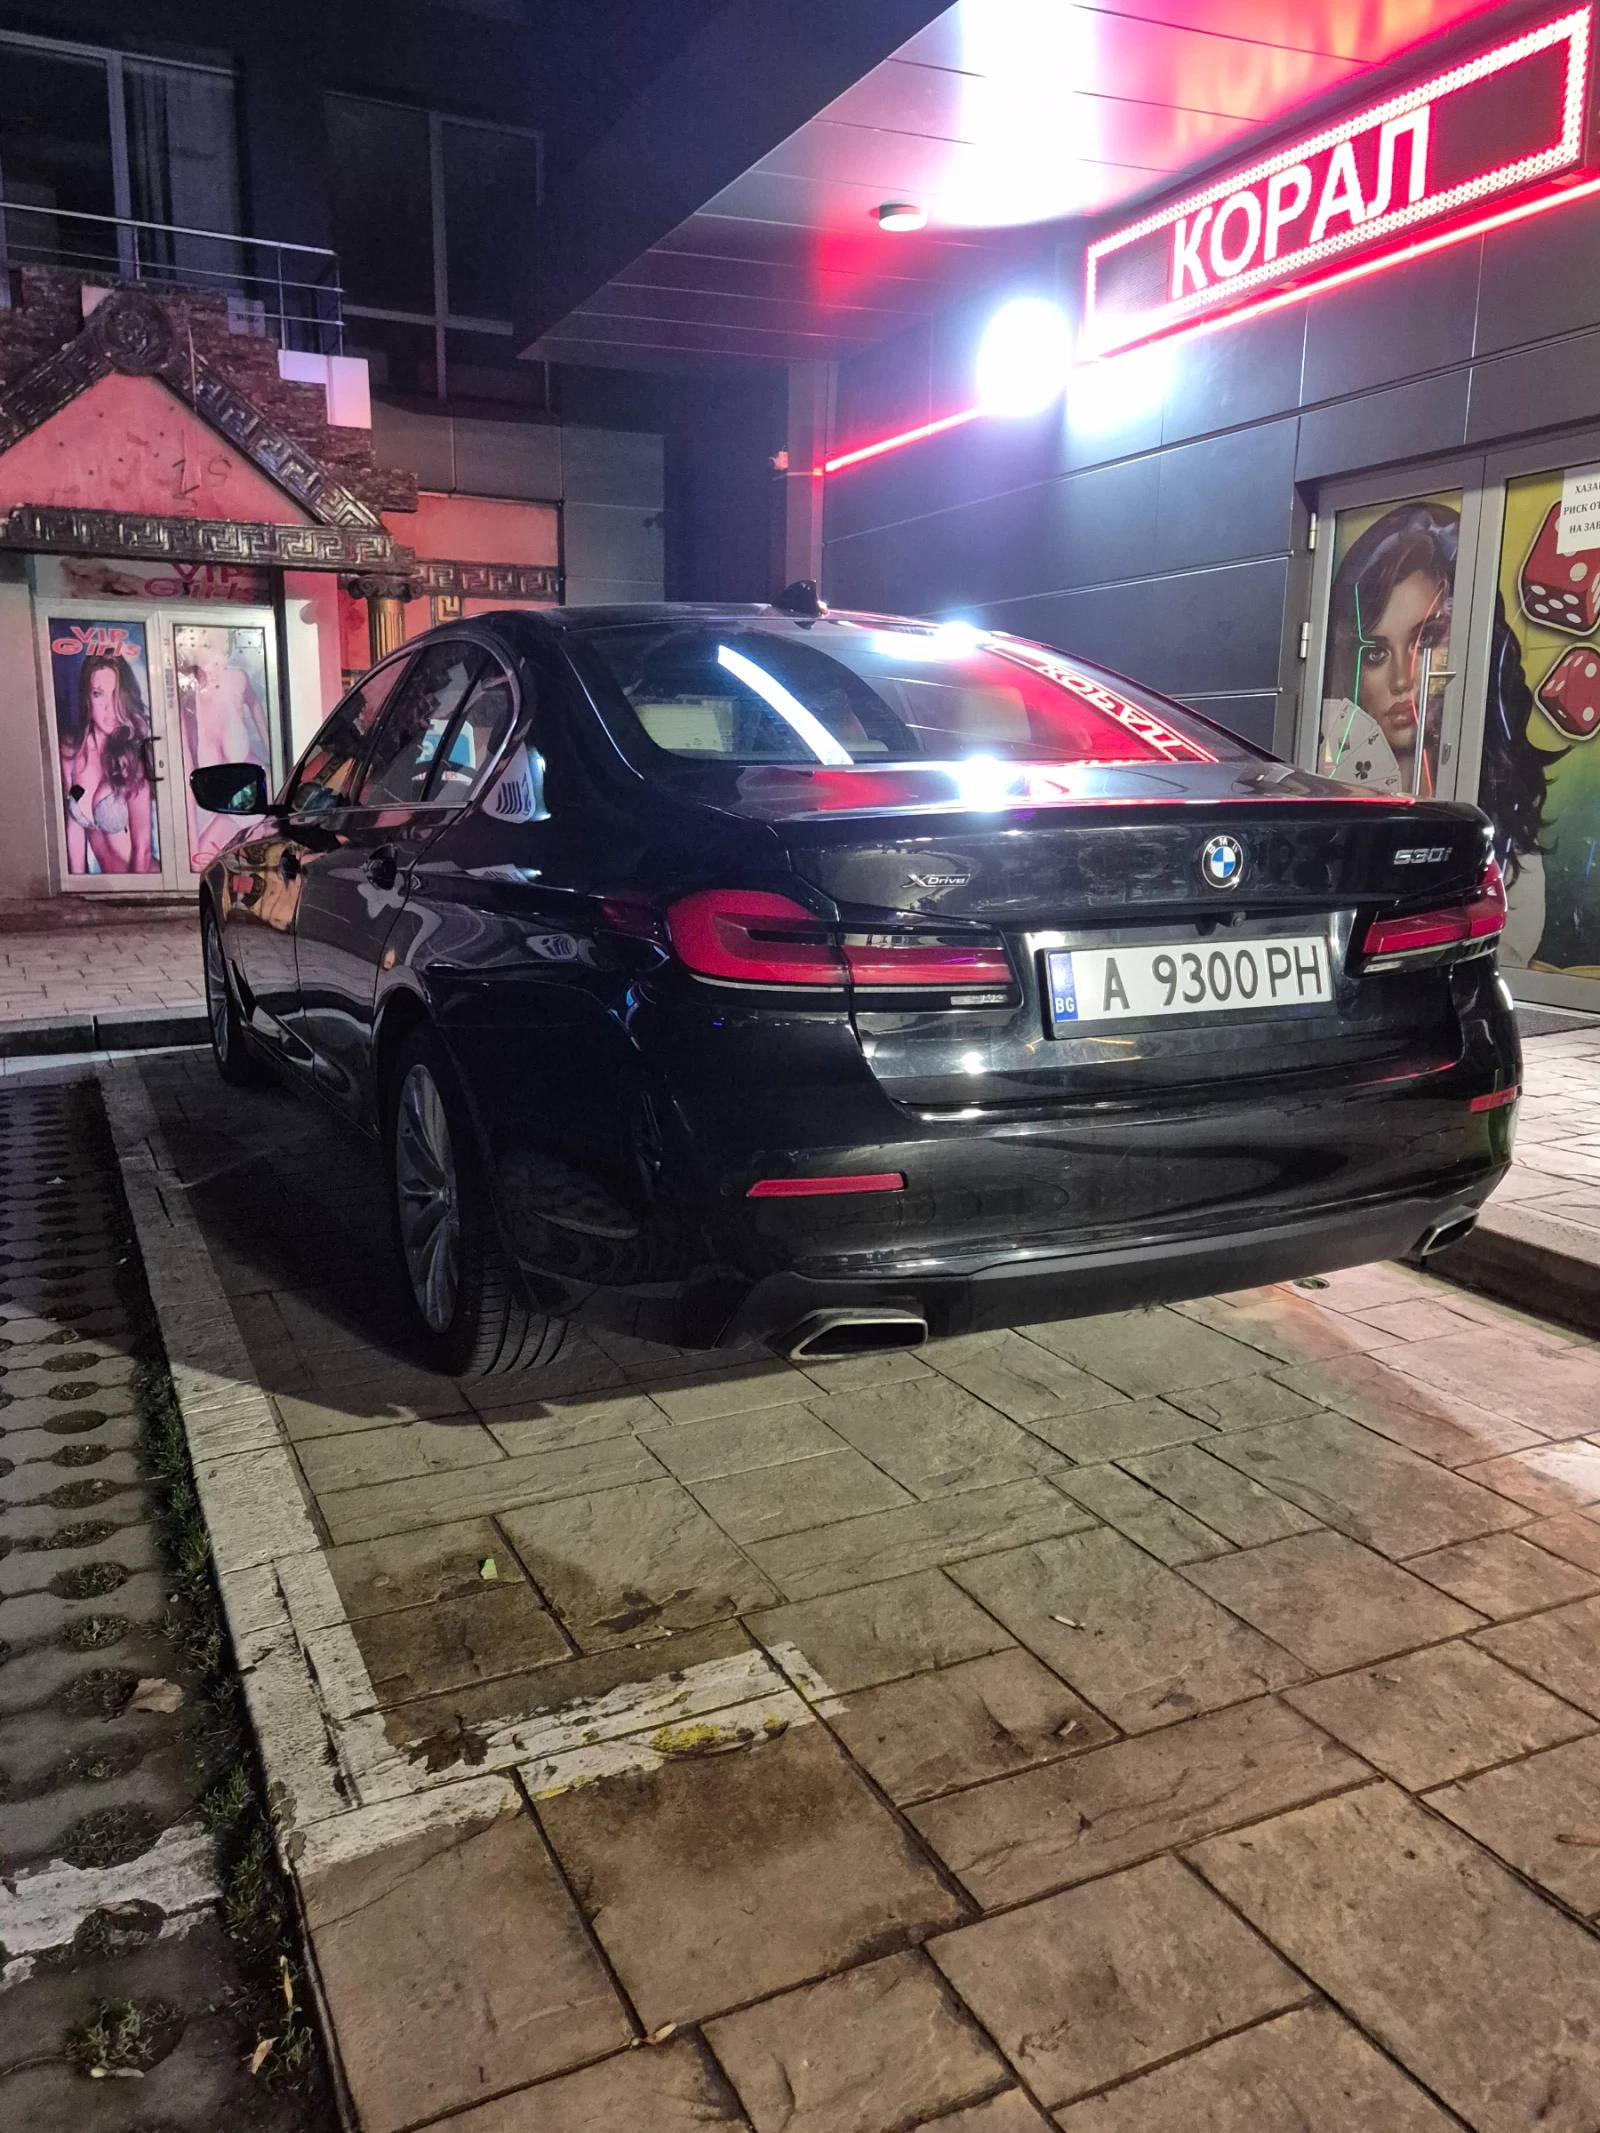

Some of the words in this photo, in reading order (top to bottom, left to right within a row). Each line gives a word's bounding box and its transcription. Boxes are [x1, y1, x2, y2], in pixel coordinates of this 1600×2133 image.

[1172, 104, 1430, 300] КОРАЛ
[1575, 481, 1600, 494] ХАЗА
[1564, 503, 1588, 515] РИСК
[1569, 523, 1582, 534] НА
[70, 626, 129, 643] VIP
[52, 638, 142, 657] Girls
[1393, 847, 1453, 865] 530i
[1103, 957, 1130, 1011] A
[1152, 949, 1258, 1006] 9300
[1055, 997, 1075, 1013] BG
